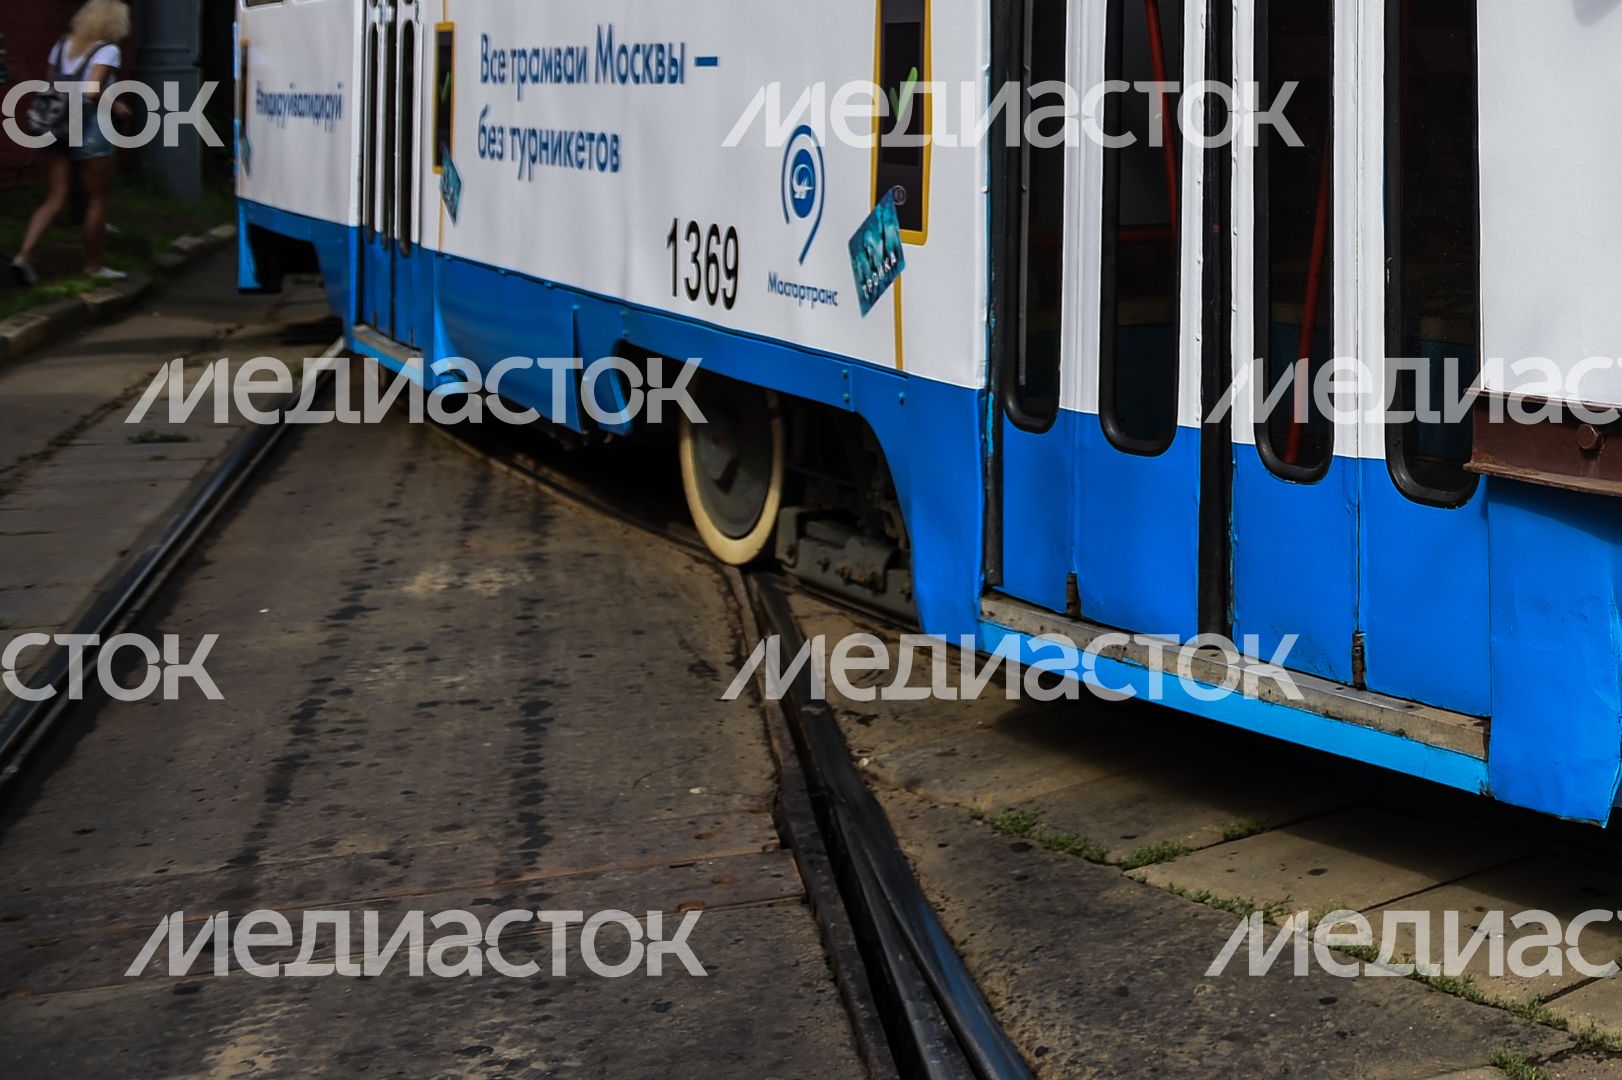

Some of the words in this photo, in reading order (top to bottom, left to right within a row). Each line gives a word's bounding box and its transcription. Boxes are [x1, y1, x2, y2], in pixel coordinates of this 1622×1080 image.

[480, 33, 506, 84] Все
[510, 45, 588, 101] трамваи
[595, 23, 685, 85] Москвы
[477, 104, 504, 160] без
[509, 126, 622, 182] турникетов
[666, 217, 739, 310] 1369
